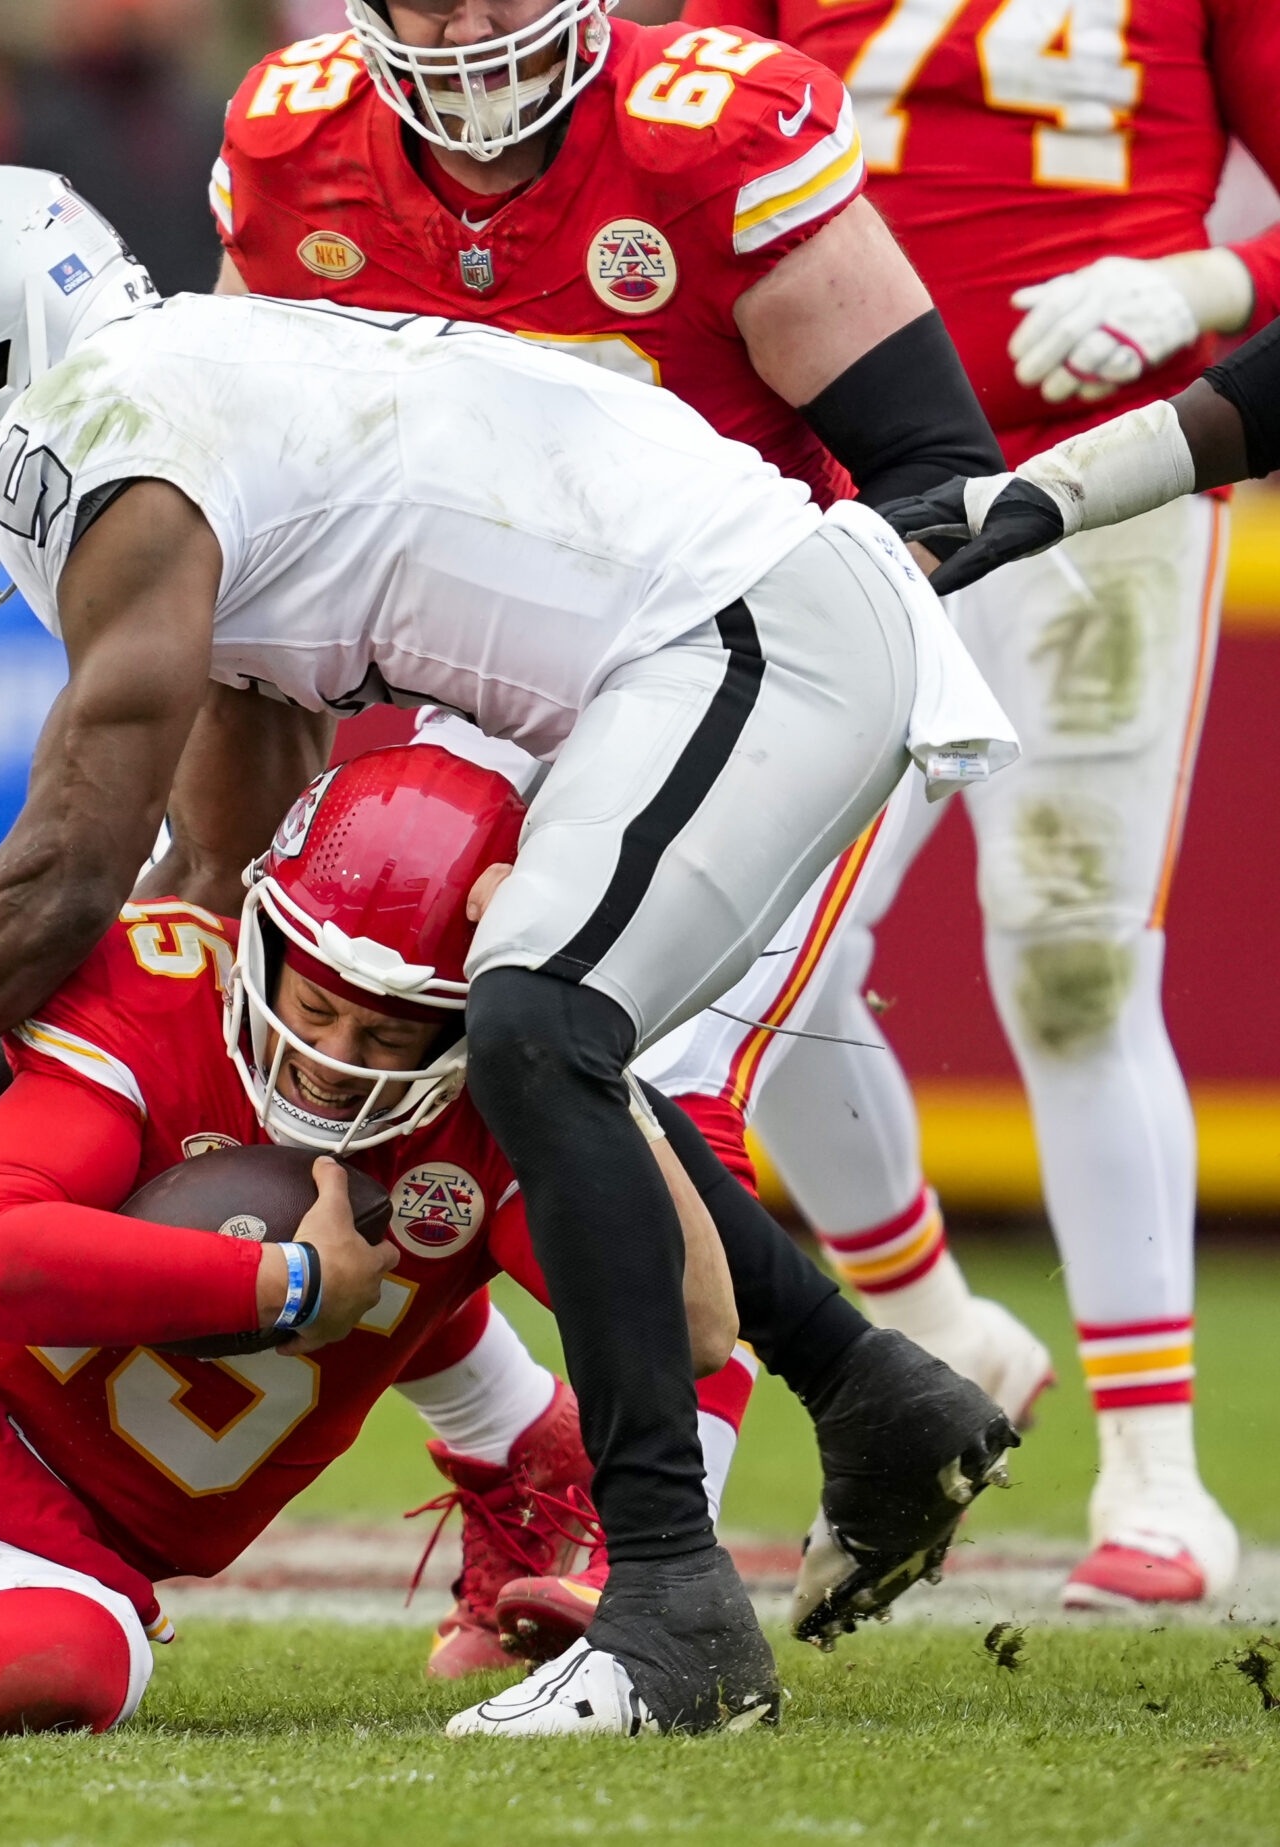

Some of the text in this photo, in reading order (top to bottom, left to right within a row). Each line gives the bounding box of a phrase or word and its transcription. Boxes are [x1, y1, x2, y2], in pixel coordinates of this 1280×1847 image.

[246, 27, 363, 119] 62
[624, 27, 783, 130] 62
[818, 0, 1143, 194] 74
[314, 243, 348, 268] NKH
[466, 266, 490, 287] NFL
[938, 750, 979, 760] northwest
[118, 901, 236, 993] 15
[229, 1219, 252, 1238] 158
